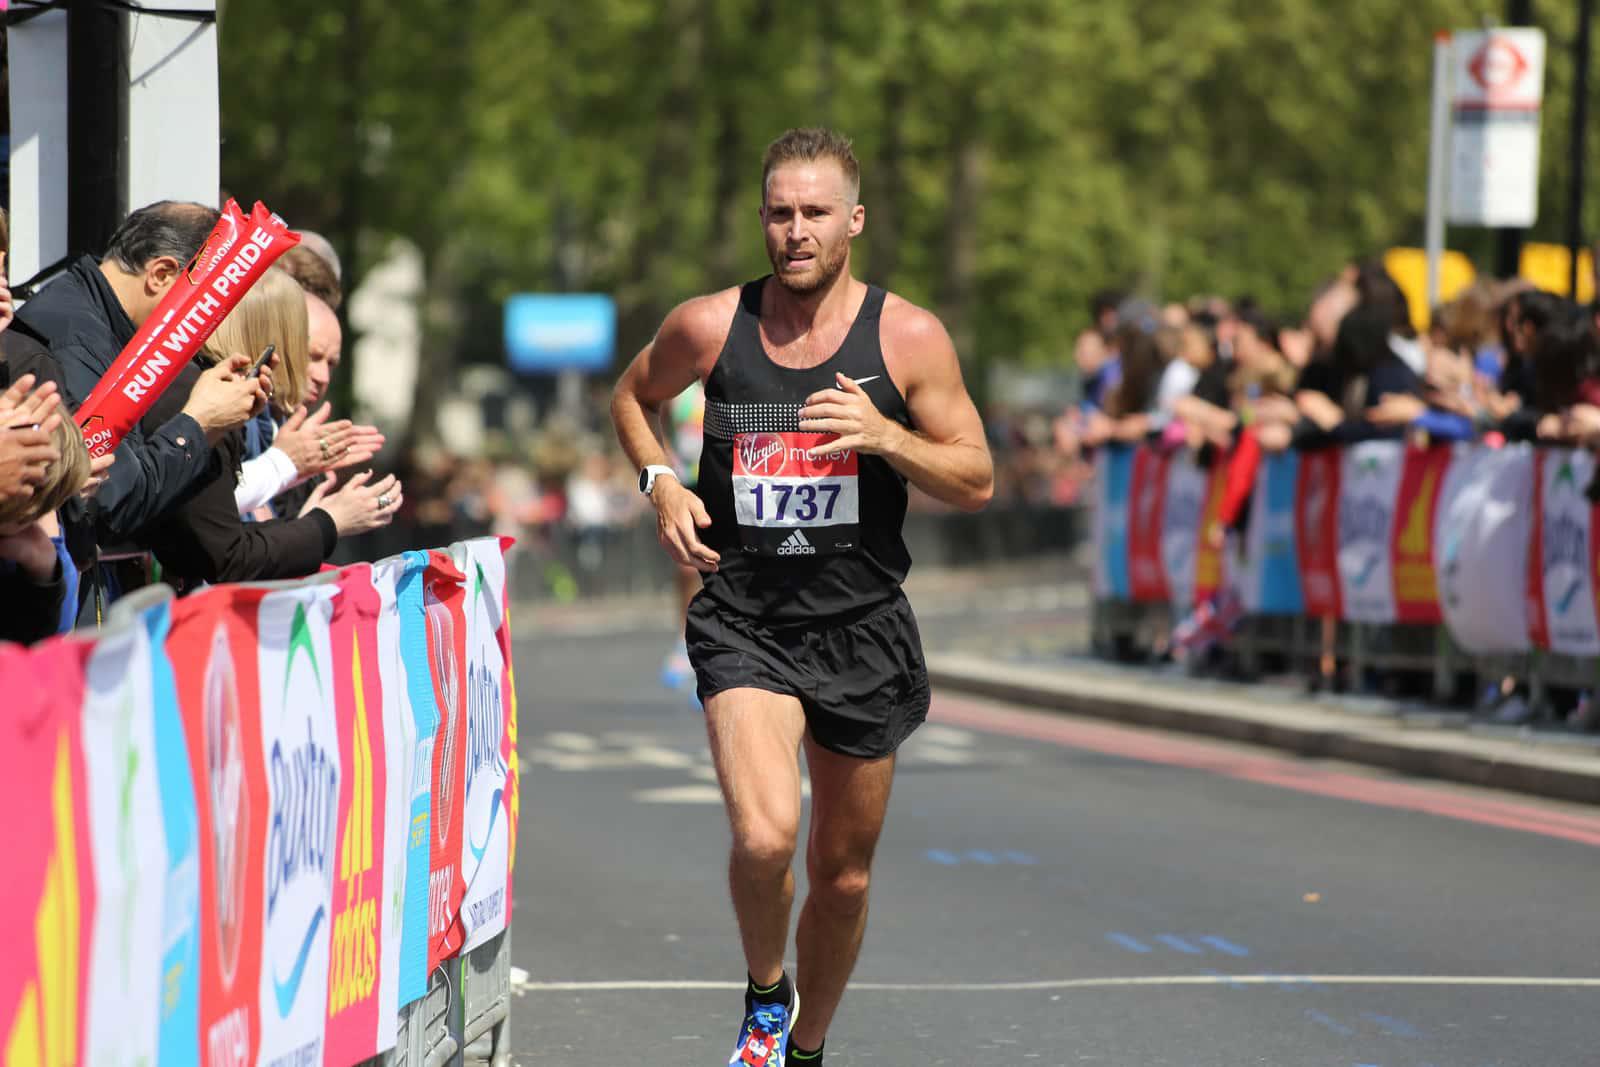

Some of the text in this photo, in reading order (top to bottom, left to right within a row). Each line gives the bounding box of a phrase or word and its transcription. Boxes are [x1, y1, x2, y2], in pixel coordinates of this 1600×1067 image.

[122, 350, 171, 403] RUN
[162, 292, 220, 352] WITH
[212, 226, 274, 297] PRIDE
[743, 433, 783, 473] Virgin
[750, 483, 841, 521] 1737
[777, 544, 816, 555] adidas
